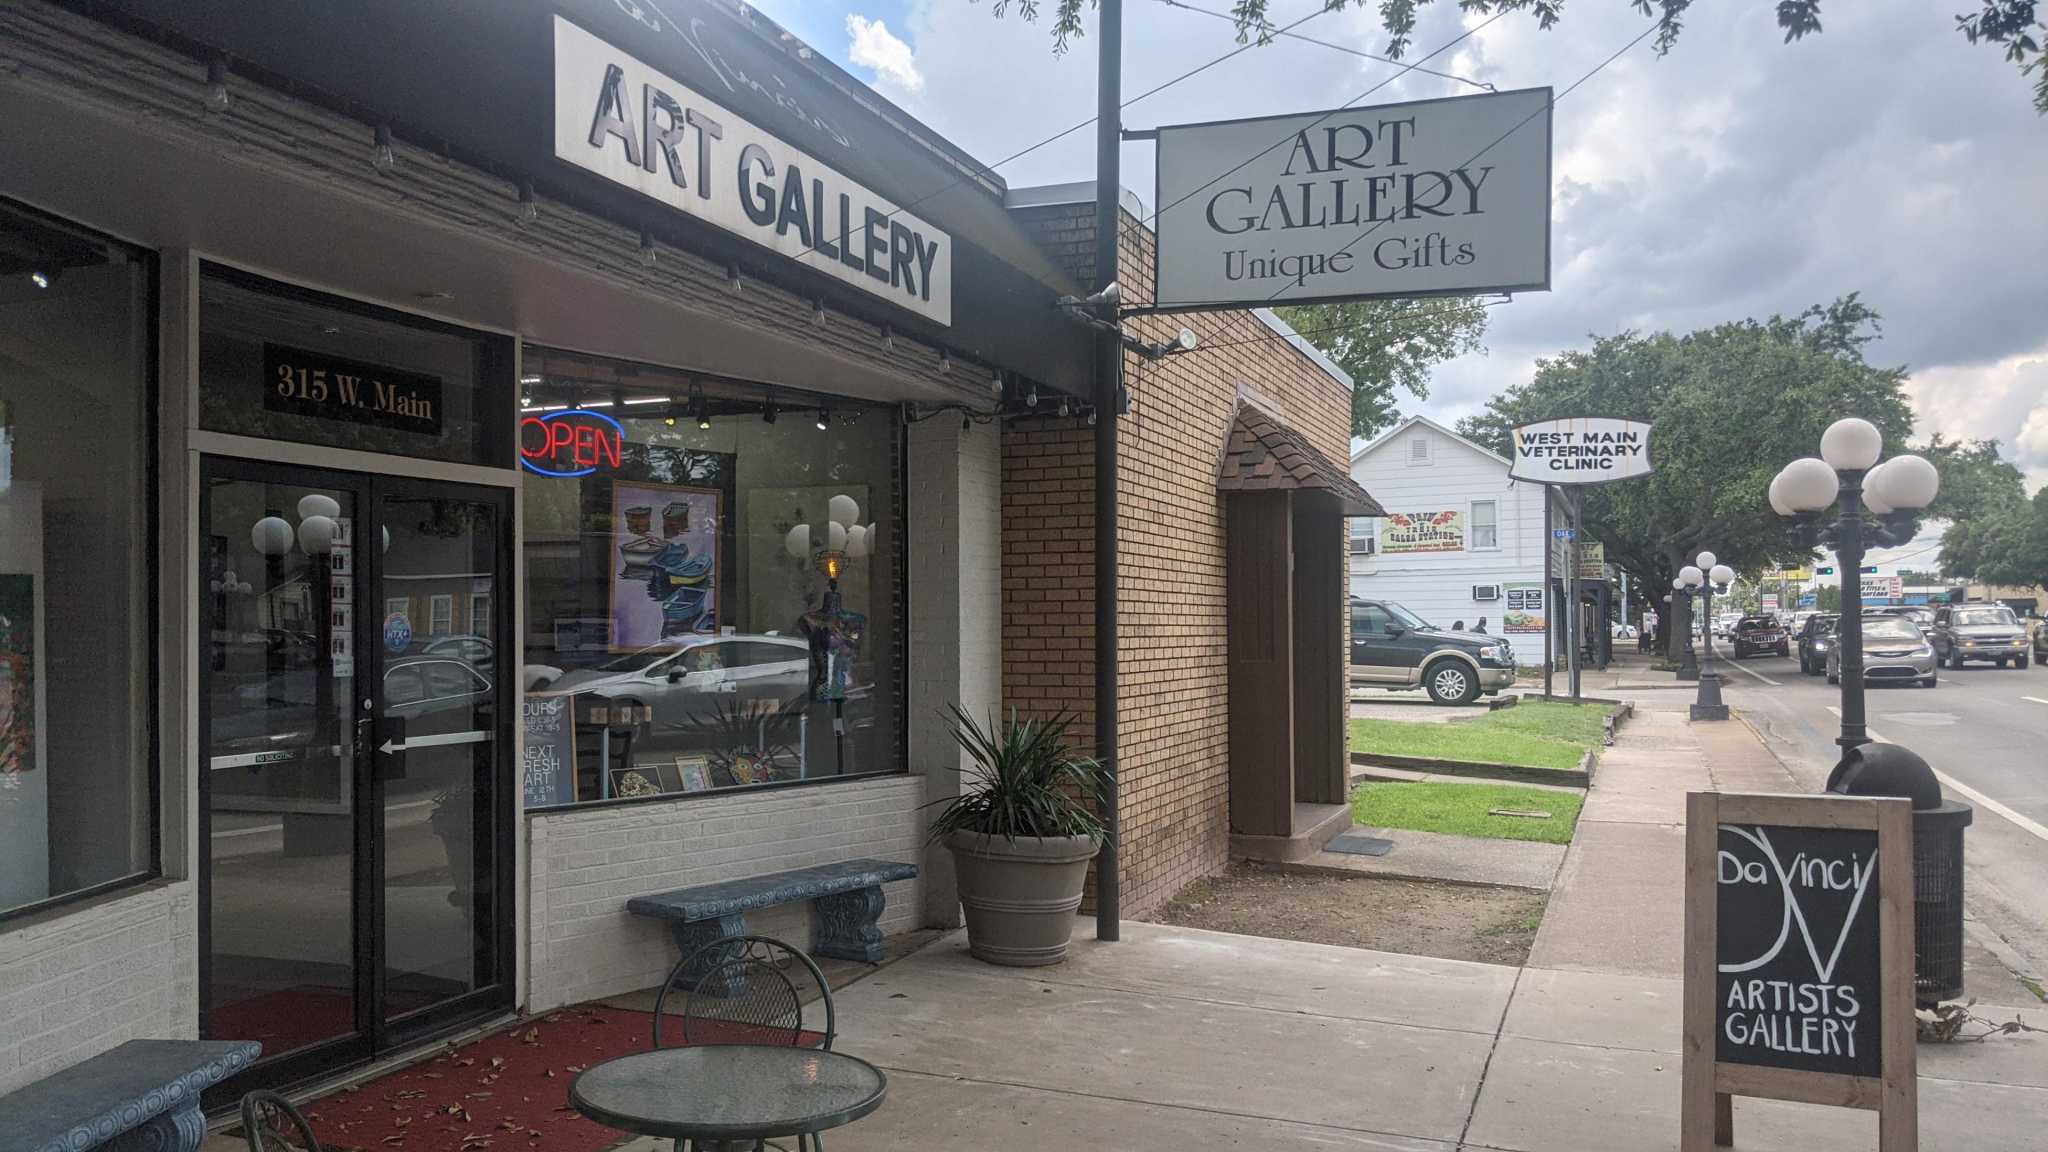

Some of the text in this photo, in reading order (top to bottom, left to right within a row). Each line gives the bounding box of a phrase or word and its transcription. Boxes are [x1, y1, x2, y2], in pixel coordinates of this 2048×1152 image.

[1280, 116, 1416, 176] ART
[588, 63, 938, 302] ART GALLERY
[1206, 166, 1495, 235] GALLERY
[1223, 232, 1476, 287] Unique Gifts
[276, 364, 433, 420] 315 W. Main
[520, 416, 622, 469] OPEN
[1518, 444, 1642, 458] VETERINARY
[1520, 431, 1637, 445] WEST MAIN
[1549, 458, 1613, 471] CLINIC
[523, 702, 557, 716] OURS
[523, 758, 560, 773] RESH
[525, 771, 551, 786] ART
[1727, 980, 1860, 1017] ARTISTS
[1725, 1012, 1857, 1058] GALLERY
